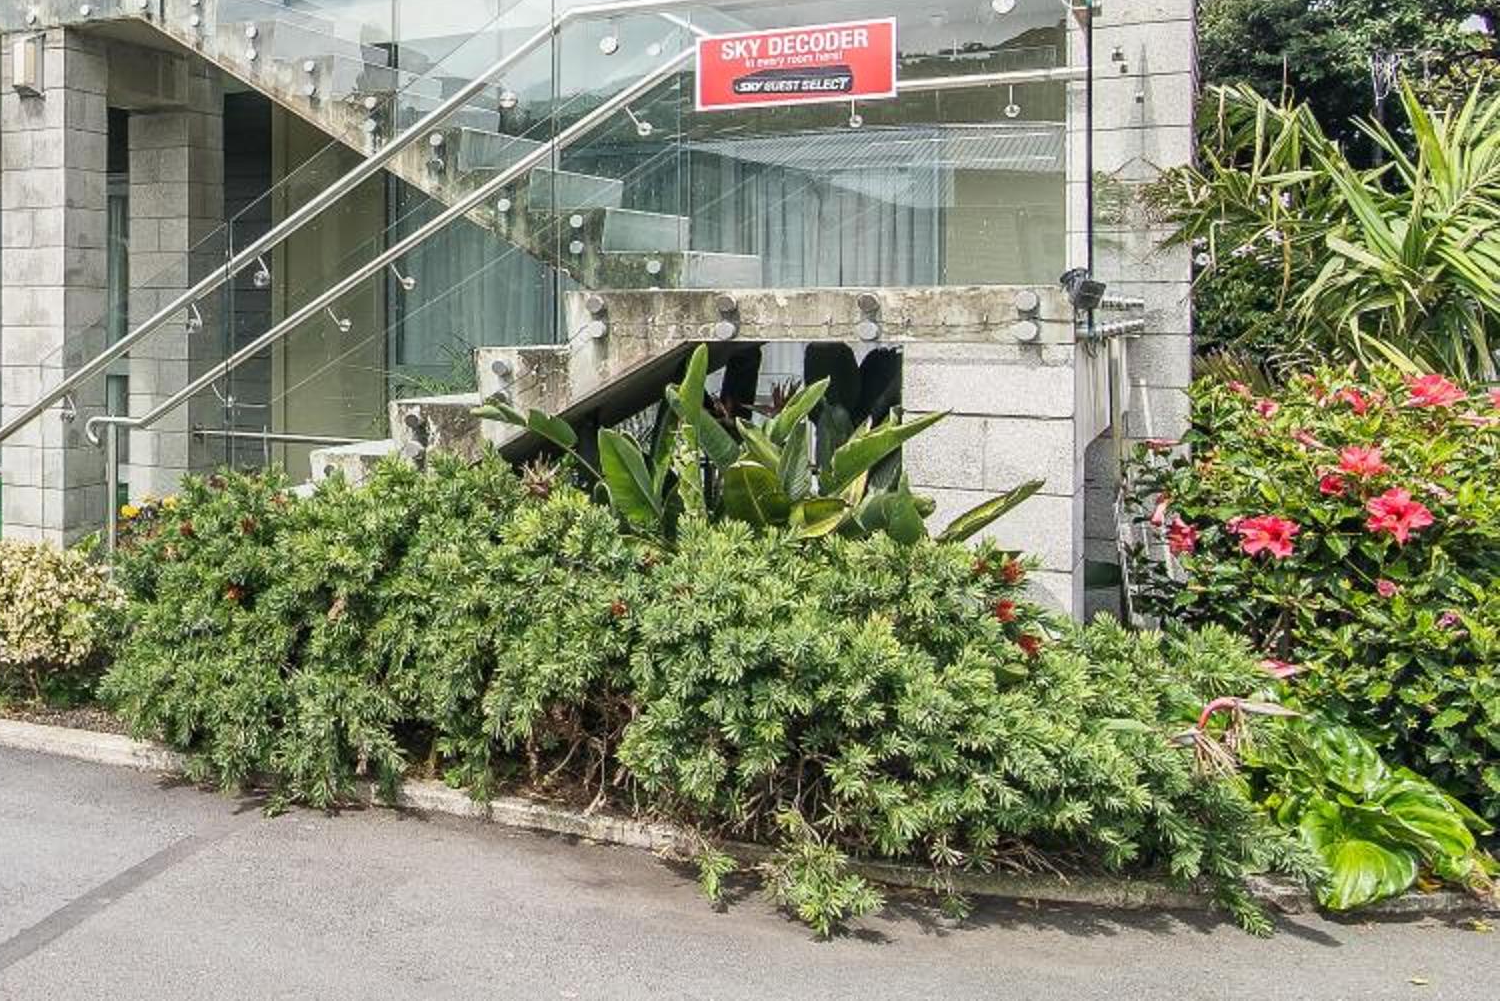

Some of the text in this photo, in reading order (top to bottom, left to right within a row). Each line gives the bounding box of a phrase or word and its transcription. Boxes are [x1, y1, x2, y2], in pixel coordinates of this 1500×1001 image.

[721, 29, 869, 60] SKY DECODER
[756, 57, 784, 68] every
[787, 54, 813, 64] room
[738, 82, 763, 92] SKY
[801, 76, 850, 90] SELECT
